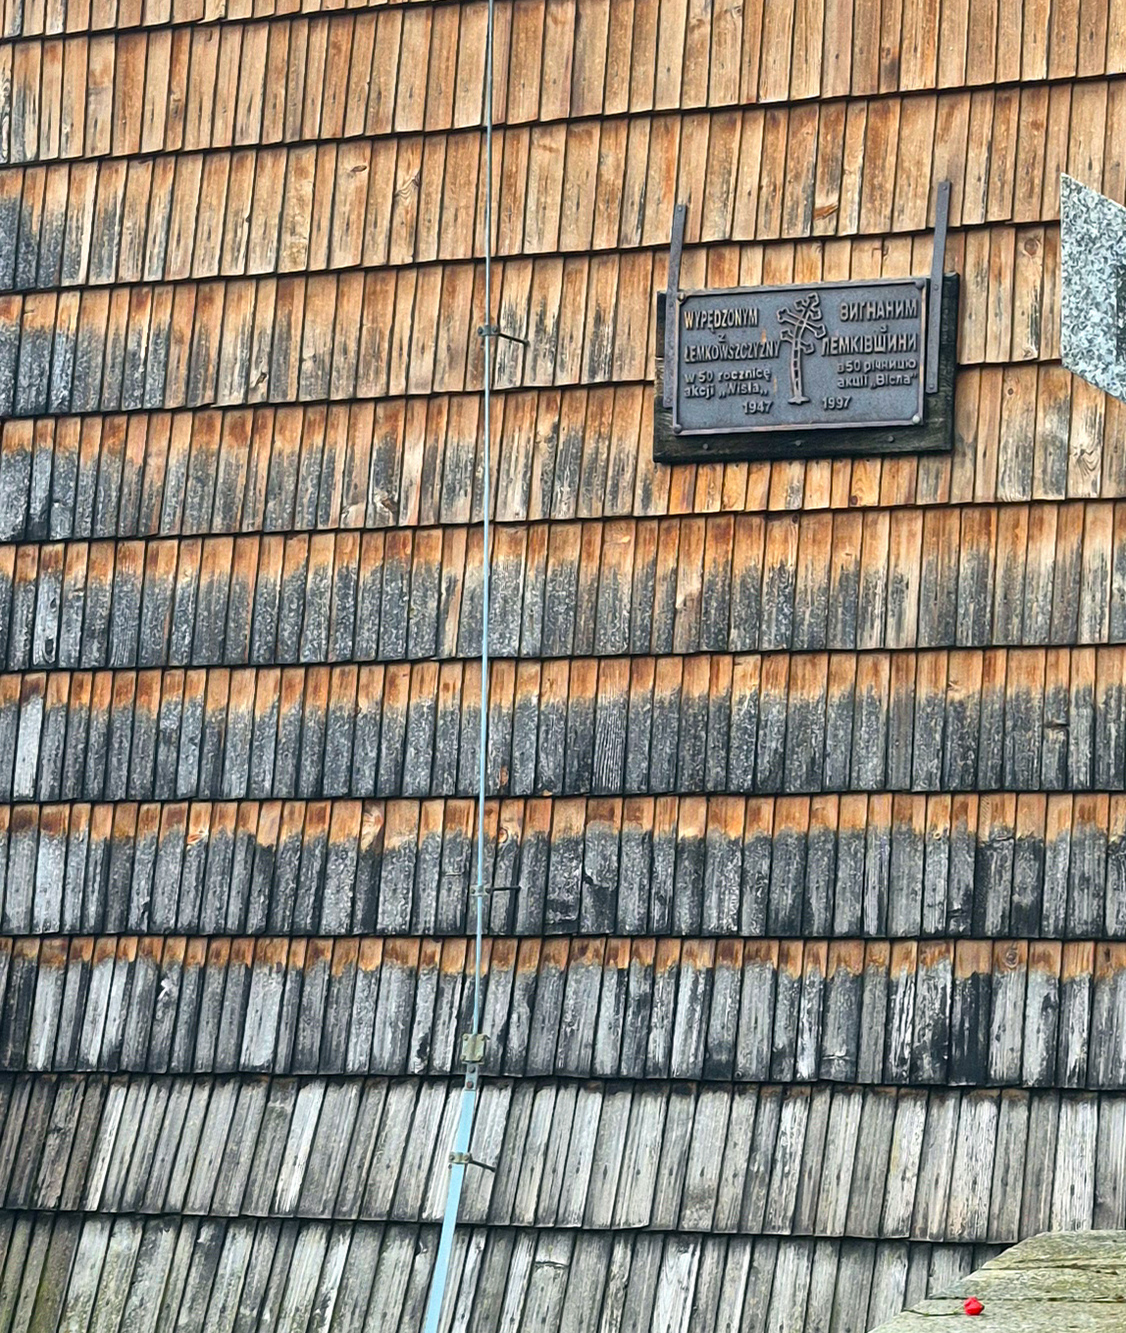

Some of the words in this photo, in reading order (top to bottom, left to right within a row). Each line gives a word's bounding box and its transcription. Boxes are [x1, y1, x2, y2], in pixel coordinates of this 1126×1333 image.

[684, 308, 759, 334] WYPĘDZONYM
[684, 340, 780, 364] ŁEMKOWSZCZYZNY
[821, 333, 918, 357] ЛЕМКІВЩИНИ
[845, 359, 861, 373] 50
[863, 358, 918, 374] річницю
[698, 370, 714, 384] 50
[718, 367, 772, 383] rocznicę
[684, 383, 715, 400] akcji
[743, 399, 774, 415] 1947
[822, 395, 852, 411] 1997
